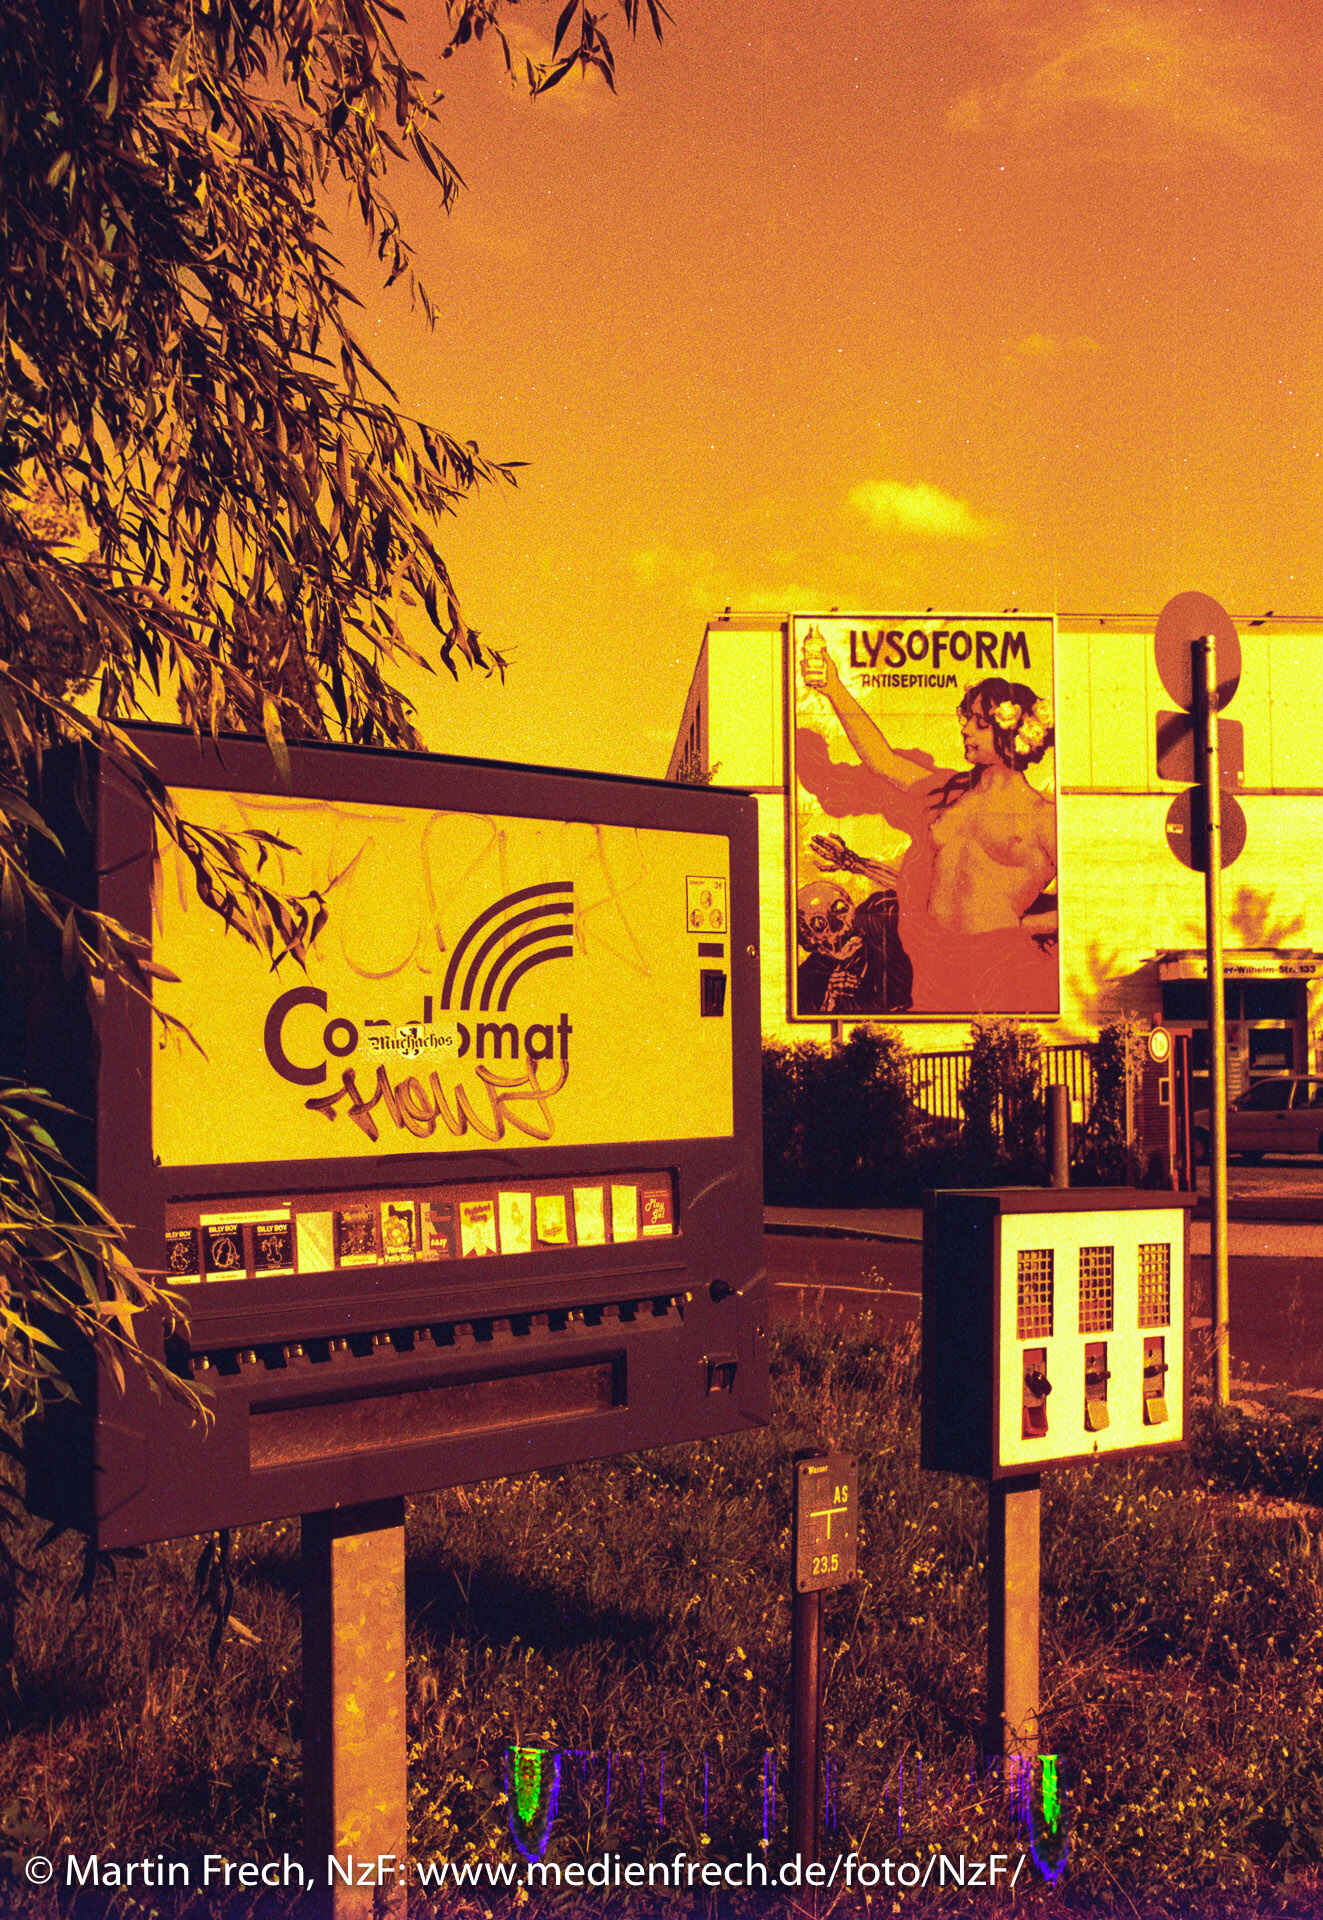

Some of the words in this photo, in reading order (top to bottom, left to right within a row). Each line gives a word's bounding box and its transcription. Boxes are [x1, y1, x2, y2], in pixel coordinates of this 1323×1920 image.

[849, 630, 1031, 669] LYSOFORM
[861, 673, 958, 689] ANTISEPTICUM
[368, 1033, 453, 1050] Muchachos
[833, 1484, 849, 1504] AS
